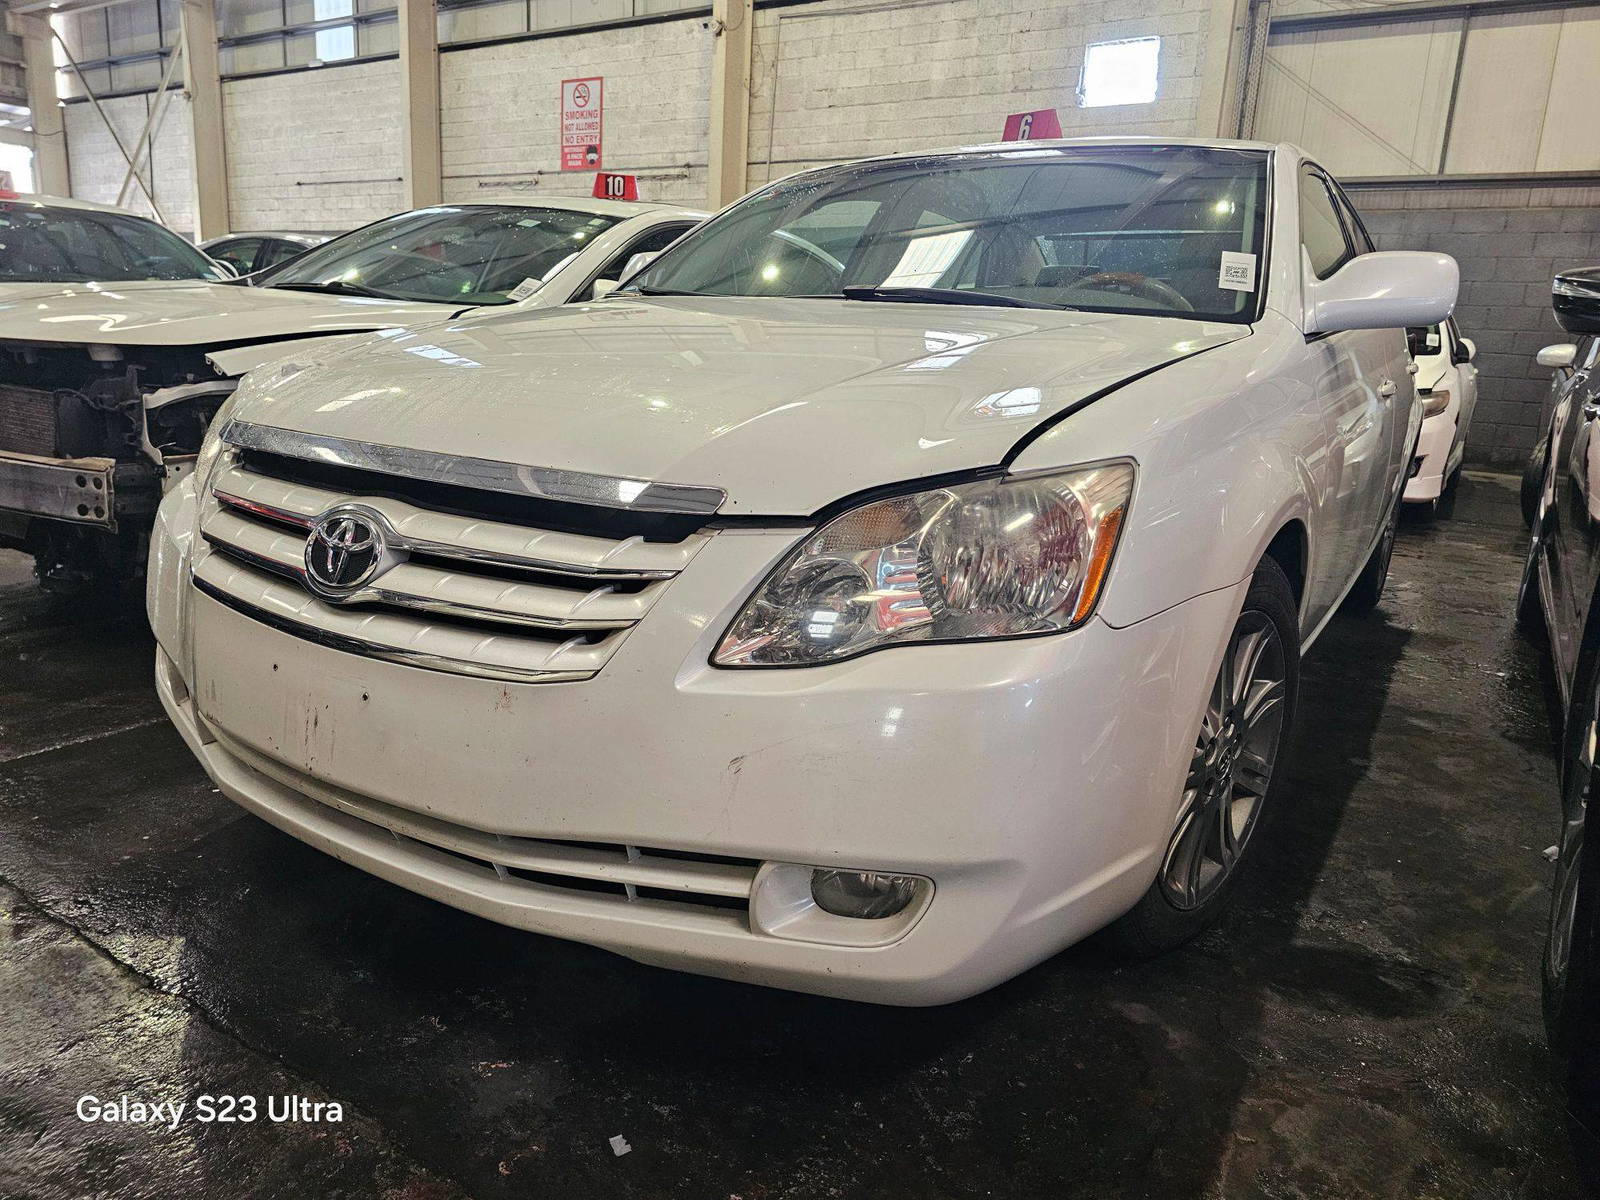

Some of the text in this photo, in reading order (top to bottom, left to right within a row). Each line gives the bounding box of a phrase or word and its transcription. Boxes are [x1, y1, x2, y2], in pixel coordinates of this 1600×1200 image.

[565, 109, 599, 120] SMOKING
[564, 121, 599, 132] NOT ALLOWED
[1018, 114, 1032, 140] 6
[564, 134, 599, 144] NO ENTRY
[607, 176, 624, 196] 10
